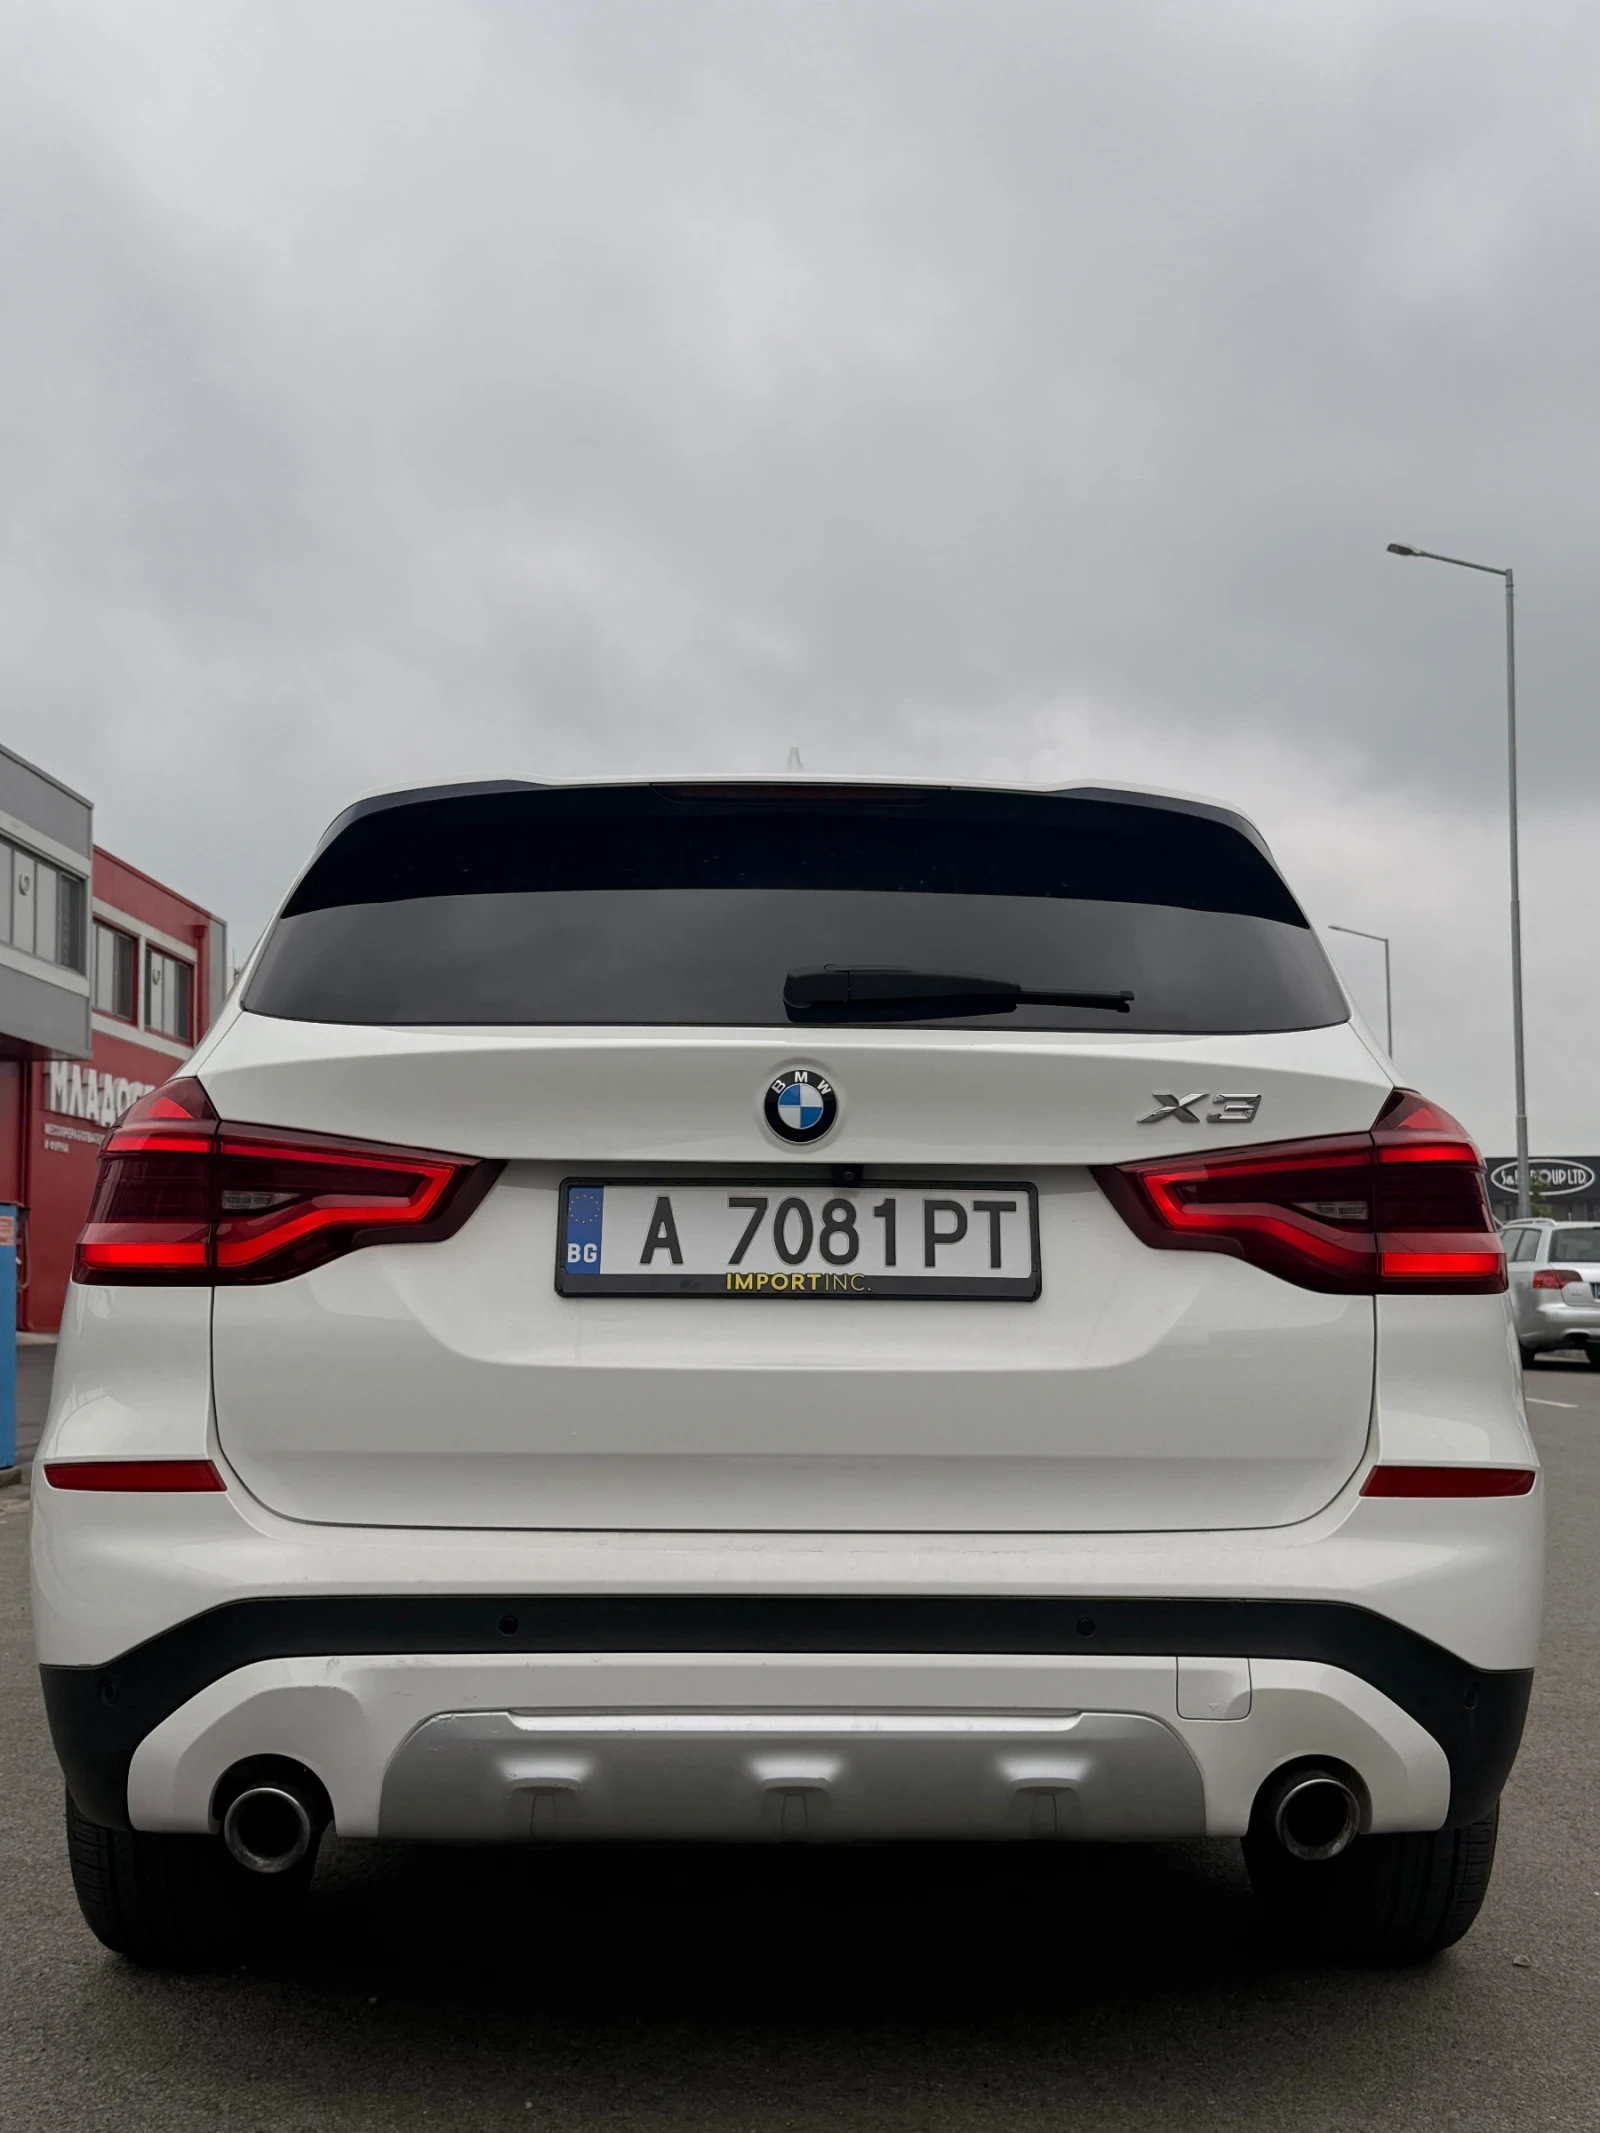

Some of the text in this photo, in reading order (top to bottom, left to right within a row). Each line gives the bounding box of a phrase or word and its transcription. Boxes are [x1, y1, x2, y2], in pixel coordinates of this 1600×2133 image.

[50, 1060, 155, 1128] МЛАДО
[771, 1071, 831, 1095] BMW
[1136, 1093, 1262, 1123] X3
[639, 1196, 684, 1265] A
[567, 1243, 598, 1264] BG
